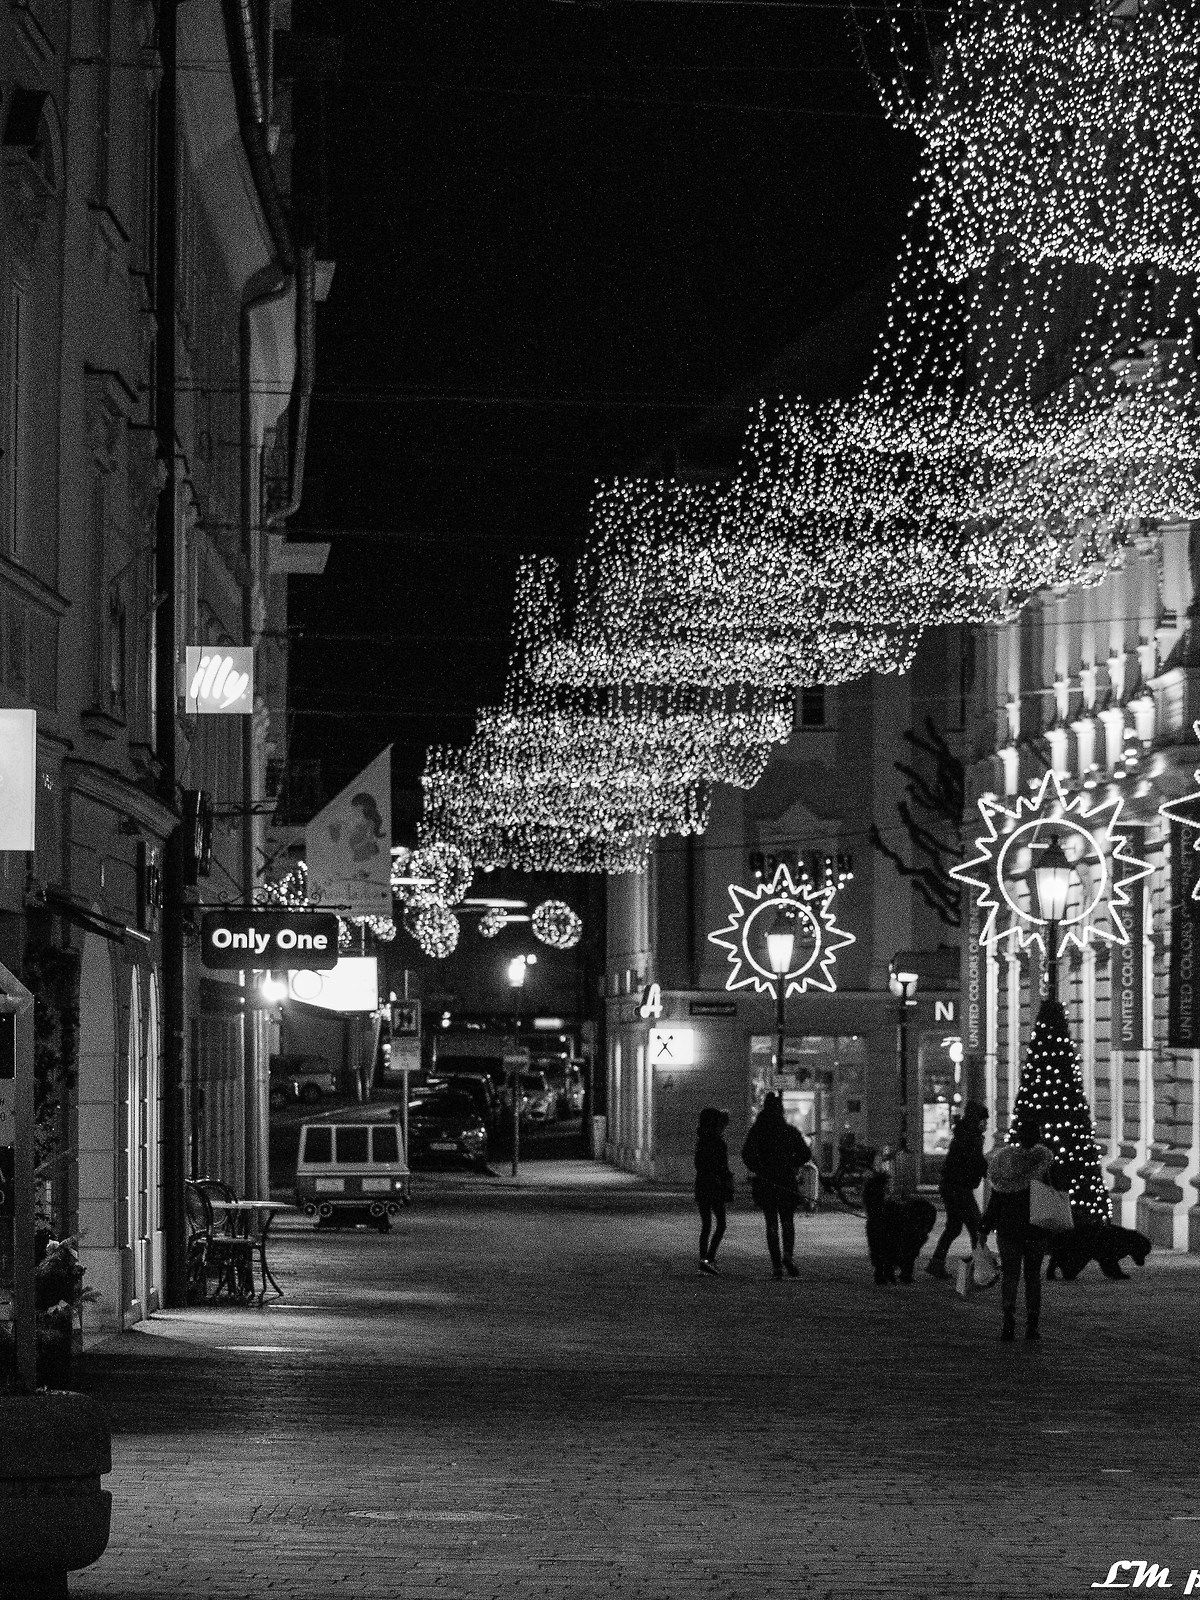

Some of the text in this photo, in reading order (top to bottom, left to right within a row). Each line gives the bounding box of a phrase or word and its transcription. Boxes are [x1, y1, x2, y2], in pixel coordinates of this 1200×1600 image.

[211, 928, 328, 954] Only One
[1180, 921, 1192, 980] COLORS
[968, 954, 979, 1002] COLORS
[968, 1003, 979, 1048] UNITED
[1121, 990, 1134, 1042] UNITED
[1180, 984, 1192, 1040] UNITED
